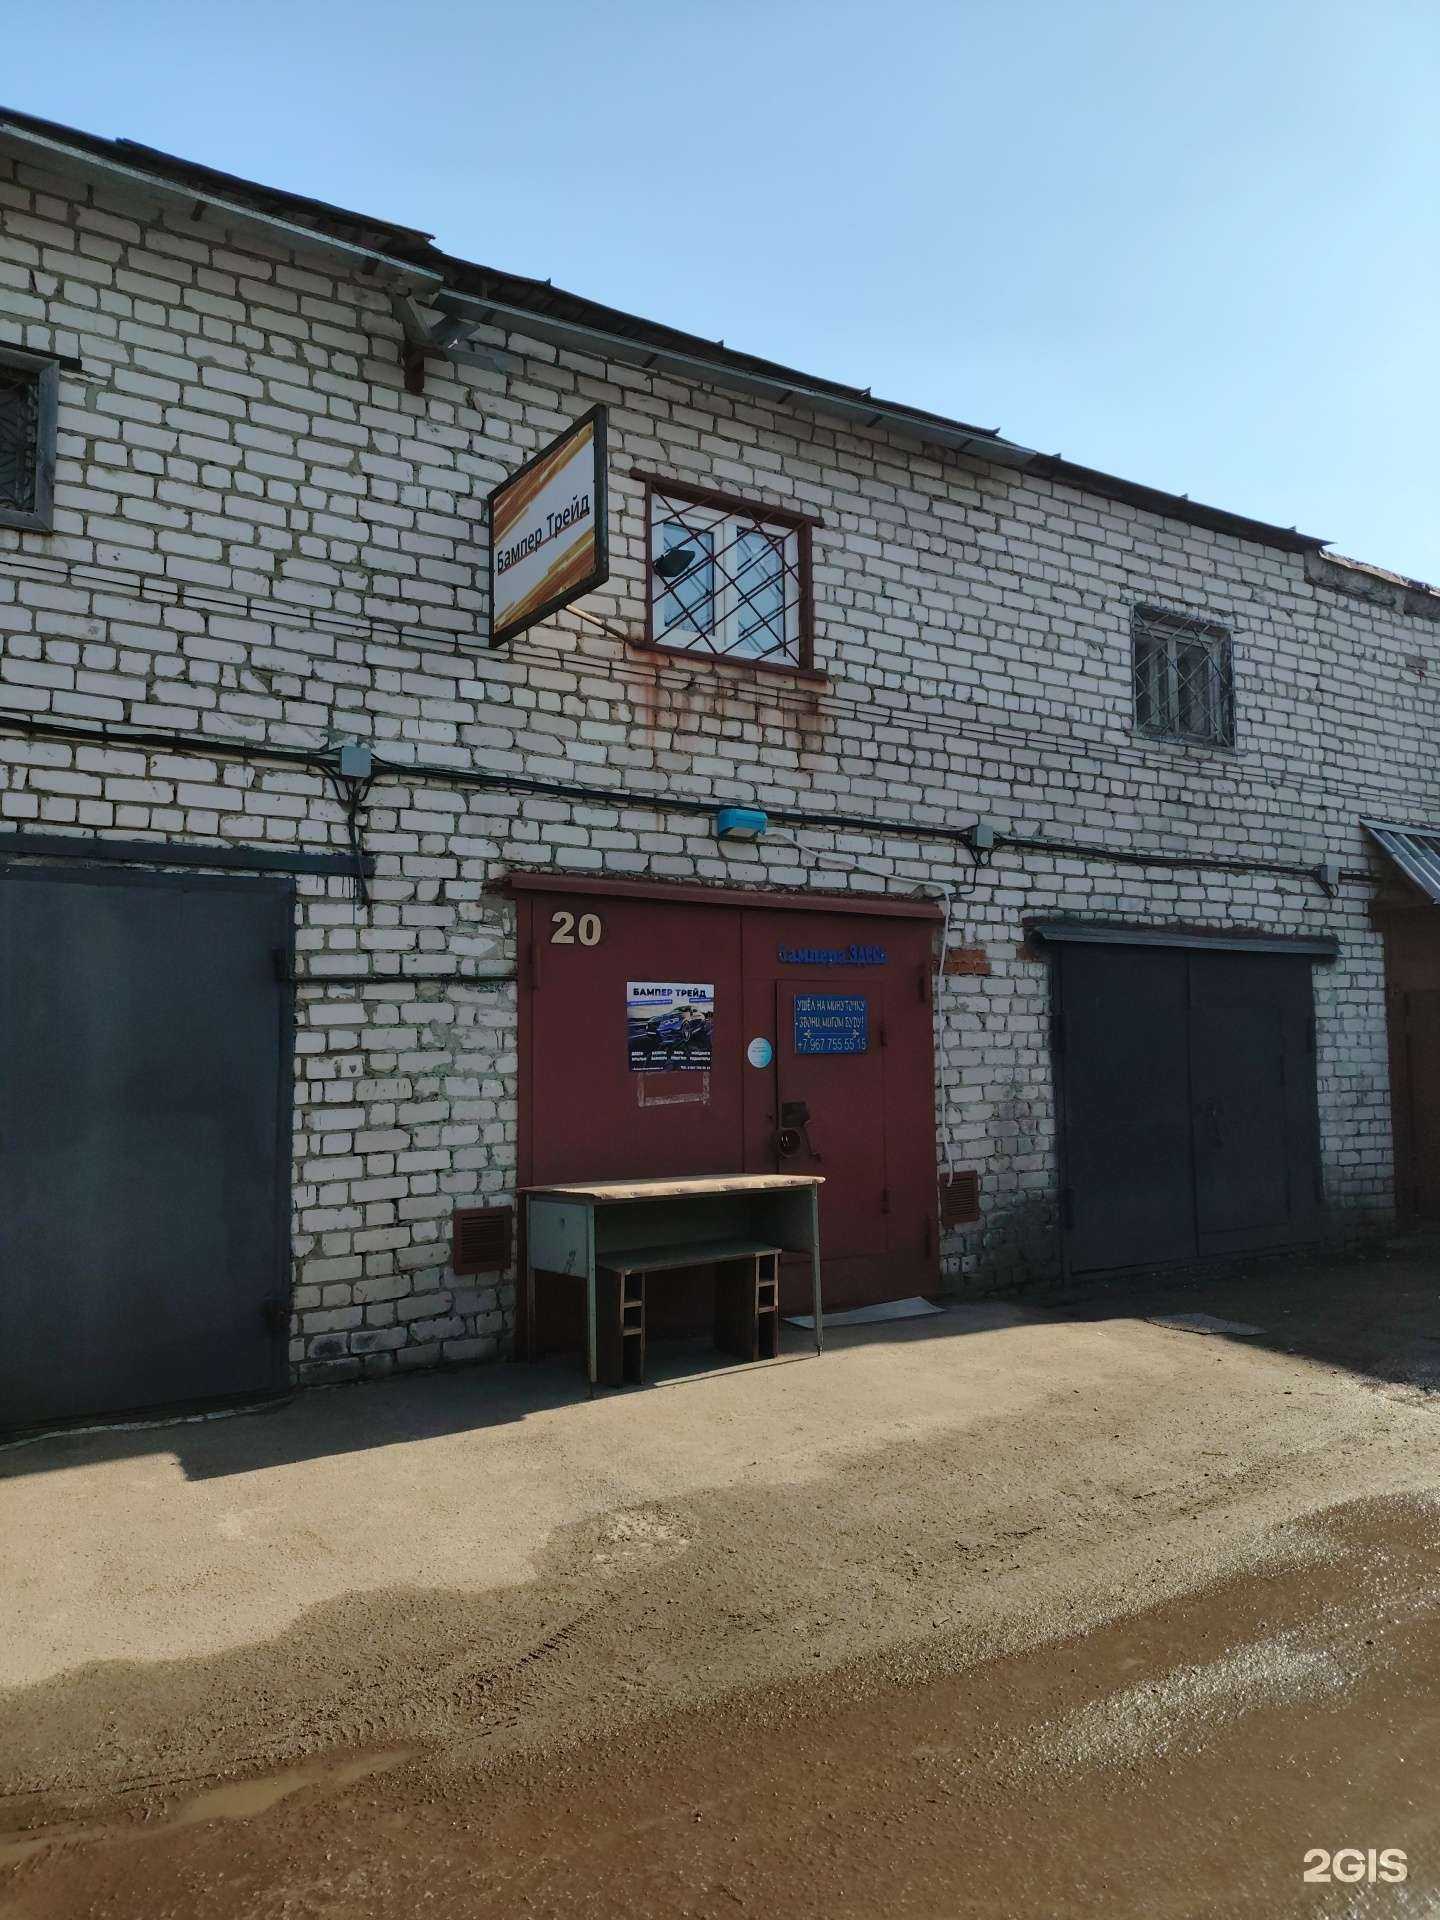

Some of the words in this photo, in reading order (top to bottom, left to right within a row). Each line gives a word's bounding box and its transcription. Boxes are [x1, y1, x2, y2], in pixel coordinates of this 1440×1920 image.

[497, 527, 542, 574] Бампер
[546, 494, 591, 538] Трейд
[550, 911, 602, 946] 20
[633, 987, 673, 997] БАМПЕР
[675, 987, 707, 999] ТРЕЙД
[816, 999, 826, 1011] НА
[827, 1038, 843, 1051] 755
[844, 1038, 856, 1051] 55
[857, 1037, 867, 1050] 15
